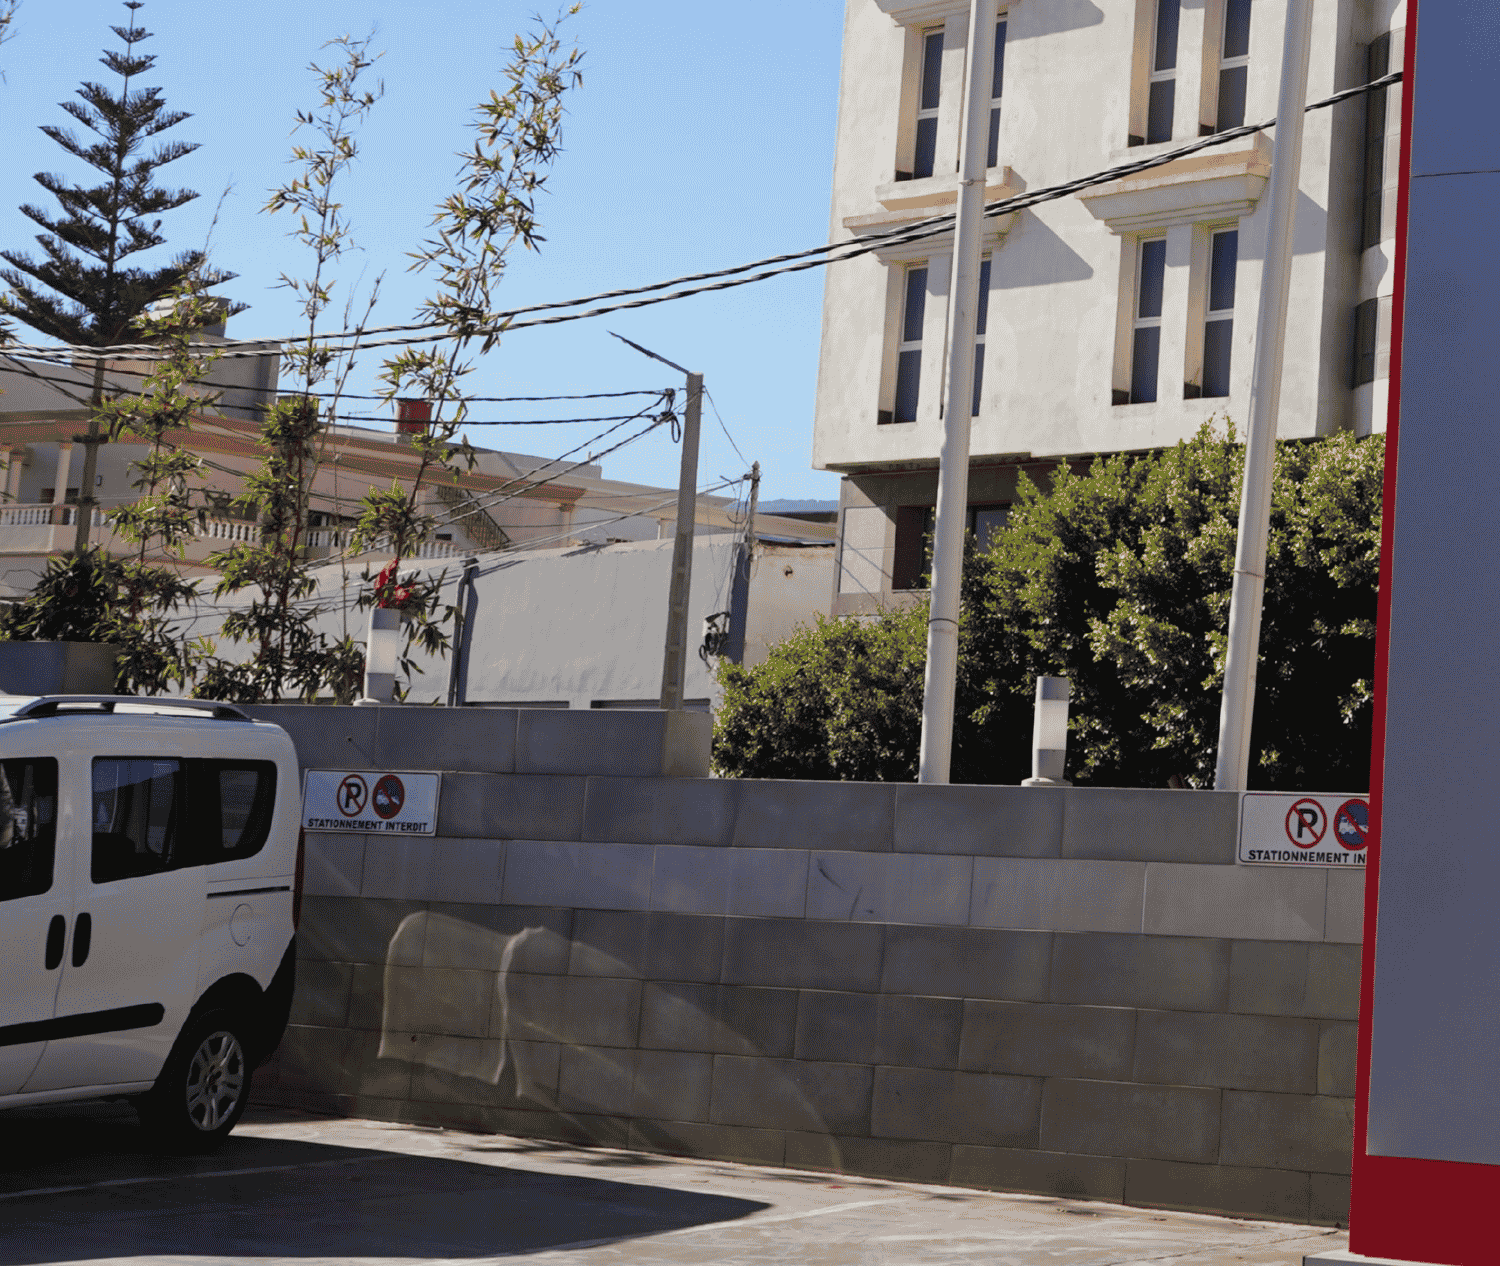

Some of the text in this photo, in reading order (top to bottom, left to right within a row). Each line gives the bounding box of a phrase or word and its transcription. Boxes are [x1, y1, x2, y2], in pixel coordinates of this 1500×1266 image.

[307, 817, 428, 832] STATIONNEMENT INTERDIT
[1248, 850, 1350, 864] STATIONNEMENT
